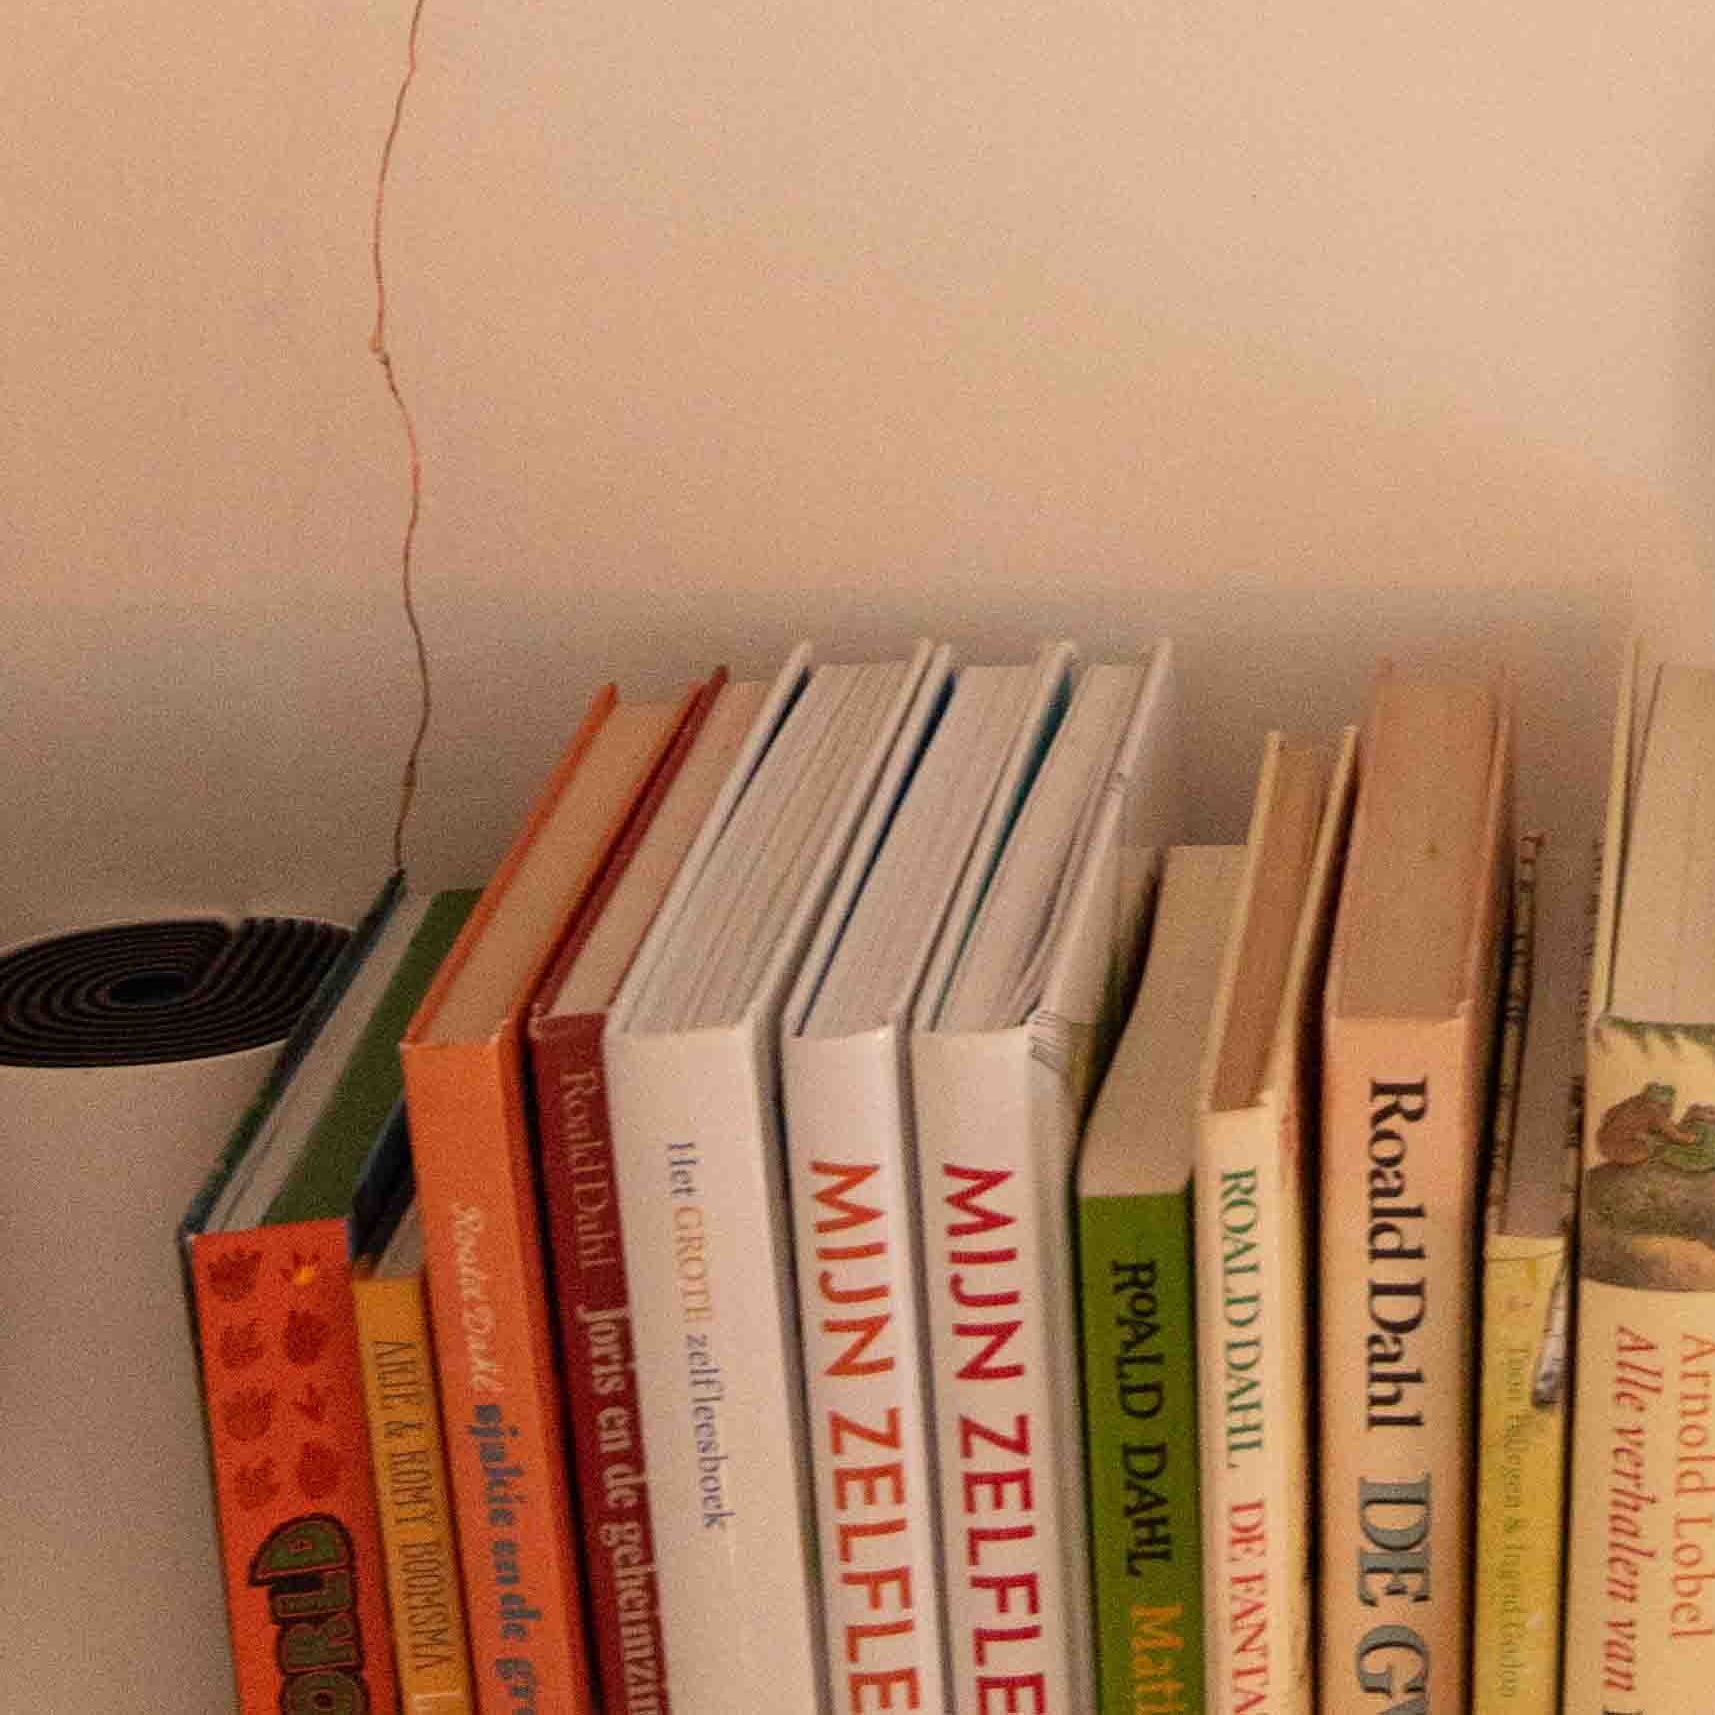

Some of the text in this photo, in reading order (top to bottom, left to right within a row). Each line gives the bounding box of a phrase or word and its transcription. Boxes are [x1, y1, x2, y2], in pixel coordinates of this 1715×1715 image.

[559, 1069, 602, 1176] Roald
[667, 1142, 698, 1197] Het
[1368, 1077, 1428, 1262] Roald
[572, 1181, 618, 1270] Dahl
[673, 1205, 714, 1324] GROTE
[810, 1162, 895, 1376] MIJN
[944, 1164, 1025, 1380] MIJN
[1220, 1167, 1263, 1328] ROALD
[576, 1304, 634, 1396] Joris
[1112, 1261, 1164, 1418] ROALD
[1367, 1279, 1427, 1431] Dahl
[1614, 1325, 1664, 1413] Alle
[385, 1421, 419, 1439] &
[599, 1408, 638, 1451] en
[1225, 1339, 1266, 1469] DAHL
[392, 1452, 434, 1525] ROMY
[603, 1464, 650, 1507] de
[1122, 1444, 1173, 1577] DAHL
[1229, 1501, 1267, 1562] DE
[1604, 1424, 1660, 1602] verhalen
[491, 1540, 524, 1584] en
[1357, 1475, 1433, 1607] DE
[401, 1542, 455, 1670] BOOMSMA
[498, 1594, 542, 1643] de
[1603, 1610, 1641, 1693] van
[496, 1657, 542, 1715] gr
